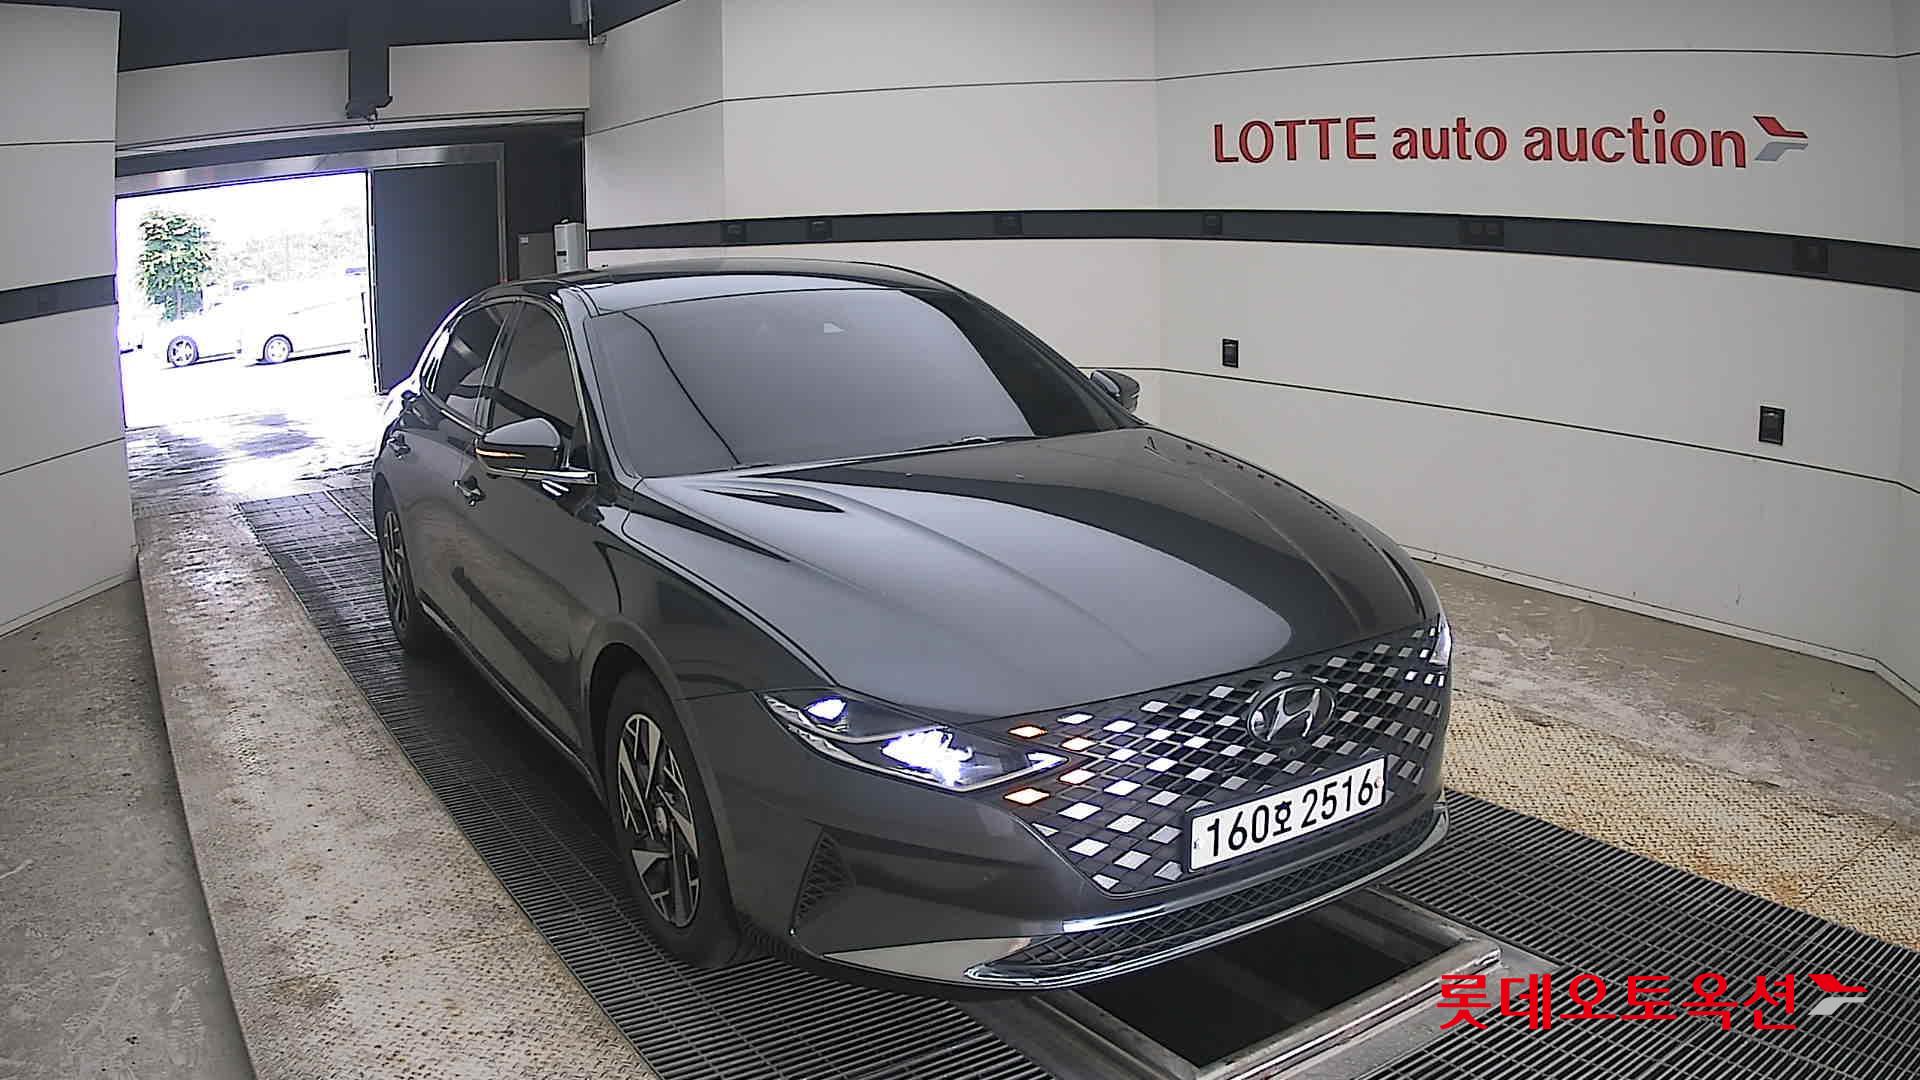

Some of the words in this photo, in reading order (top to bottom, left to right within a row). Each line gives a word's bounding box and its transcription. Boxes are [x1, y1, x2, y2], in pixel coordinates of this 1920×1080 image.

[1213, 116, 1378, 163] LOTTE
[1392, 117, 1507, 162] auto
[1523, 109, 1747, 169] auction
[1207, 800, 1293, 857] 160호
[1300, 768, 1374, 829] 2516
